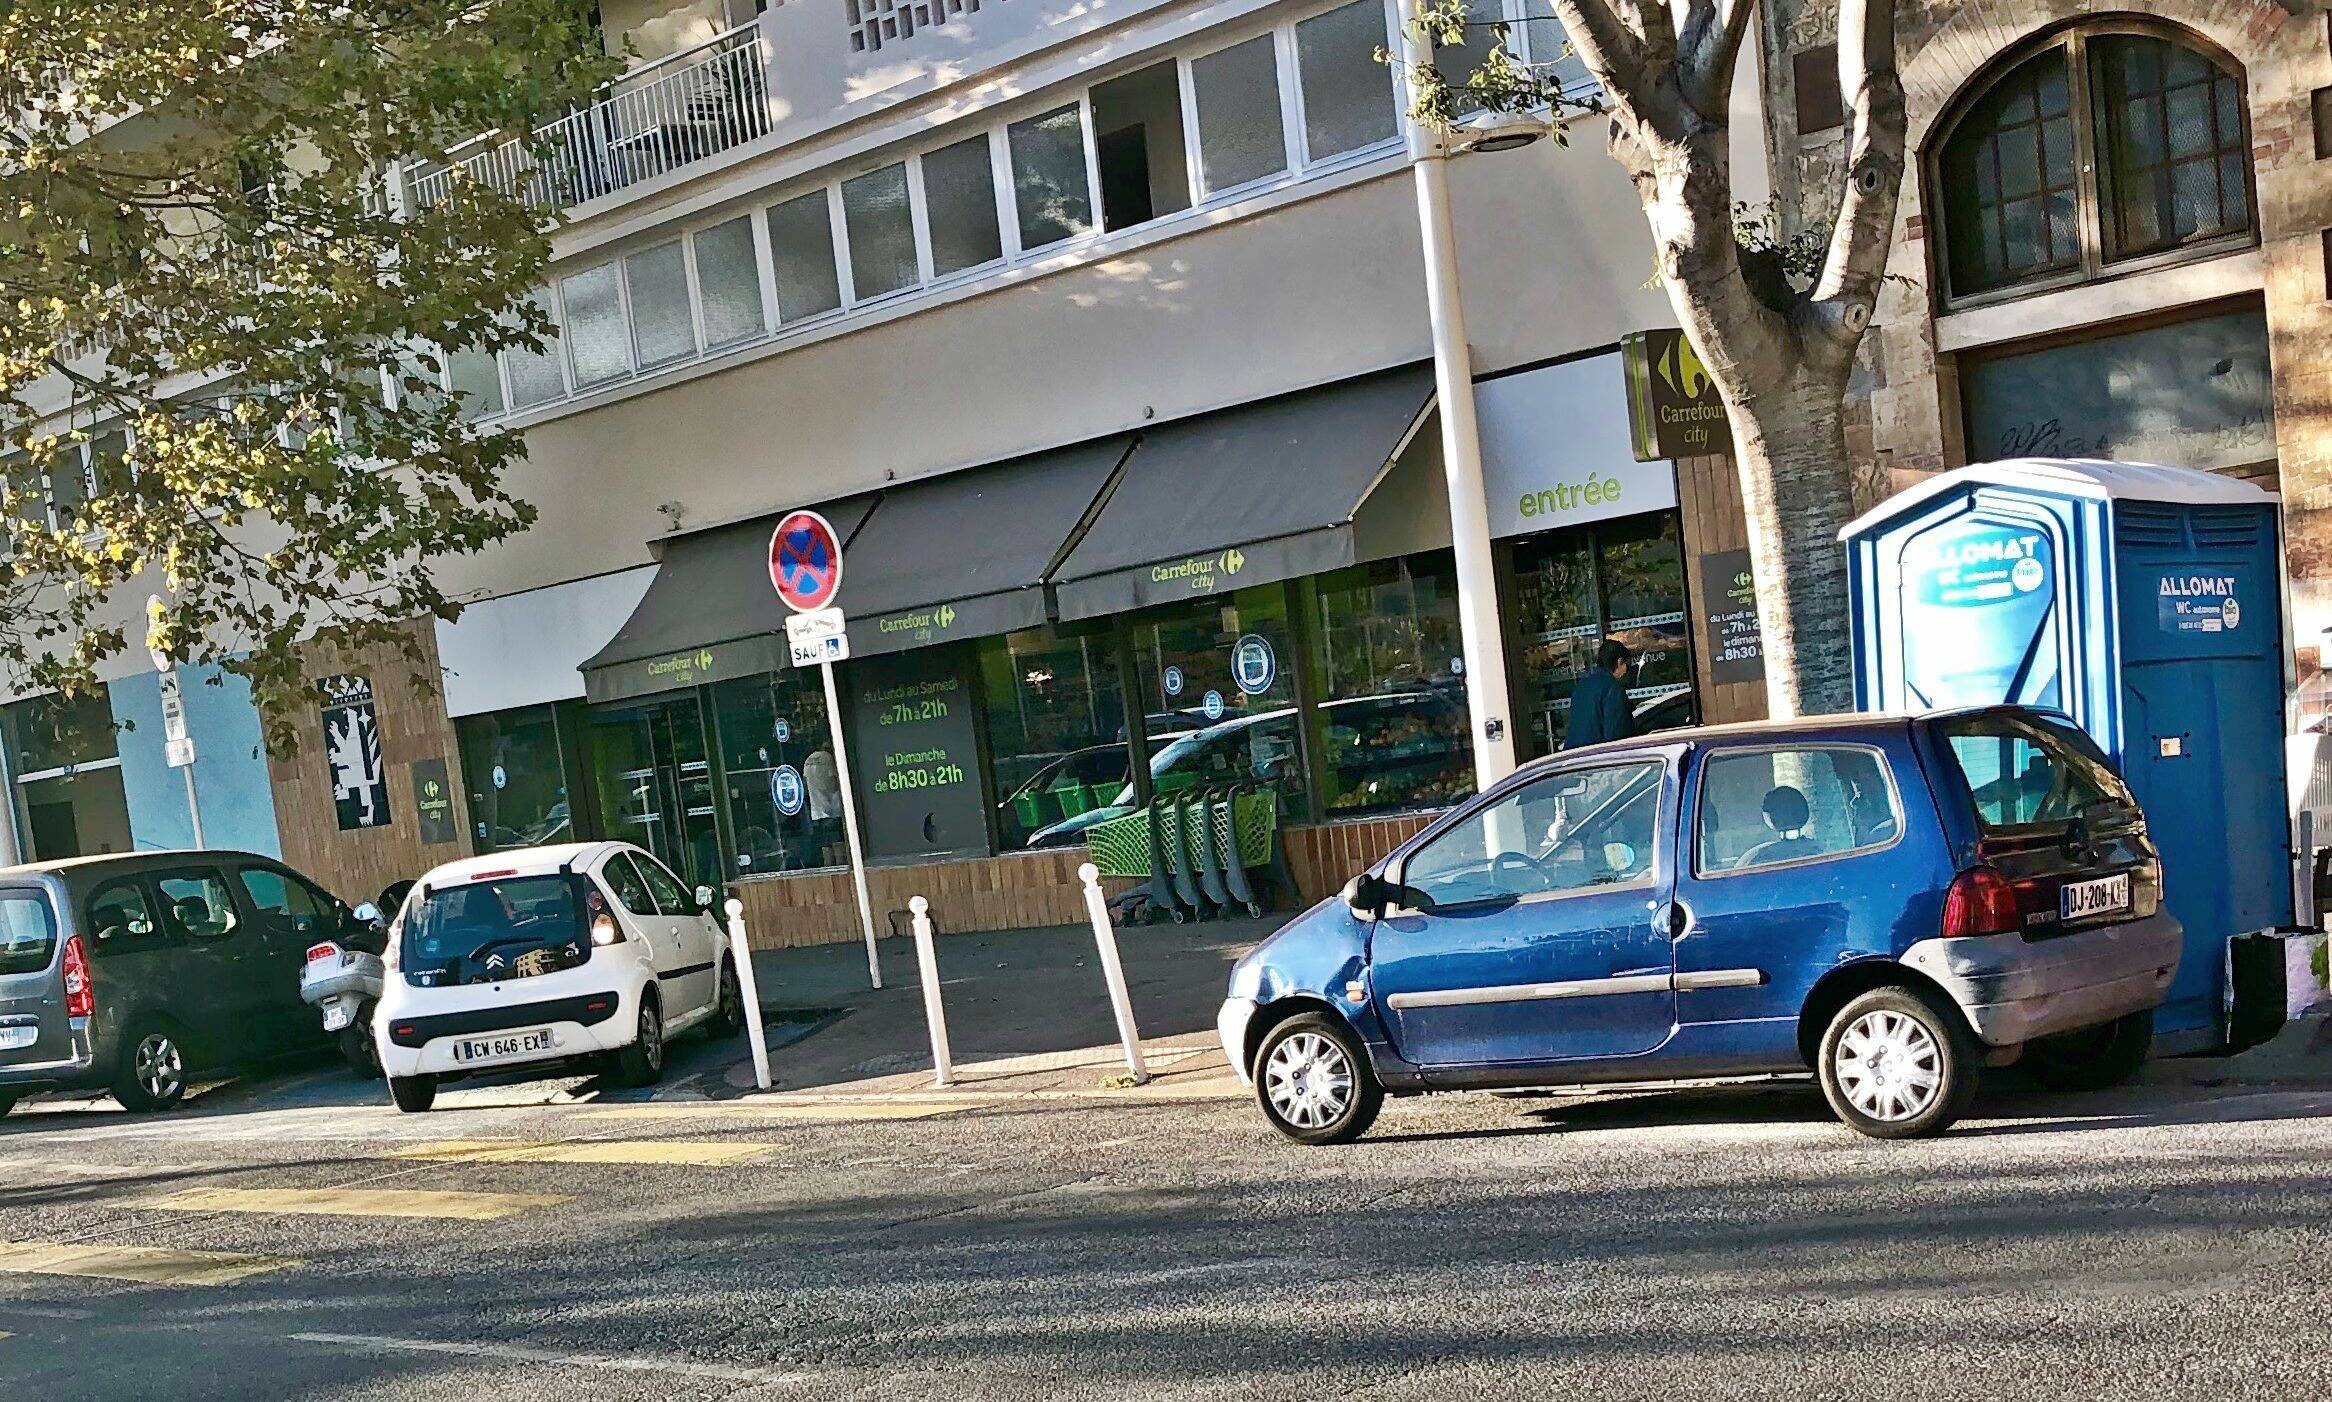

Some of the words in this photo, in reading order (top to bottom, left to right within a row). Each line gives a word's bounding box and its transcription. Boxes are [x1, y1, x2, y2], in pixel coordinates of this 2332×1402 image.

[1660, 401, 1728, 424] Carrefour
[1684, 426, 1708, 449] city
[1519, 472, 1621, 518] entrée
[1151, 559, 1215, 582] Carrefour
[1191, 575, 1215, 593] city
[2159, 577, 2235, 596] ALLOMAT
[1721, 610, 1745, 621] Lundi
[2175, 601, 2191, 614] WC
[879, 613, 931, 633] Carrefour
[1729, 621, 1746, 633] 7h
[1731, 635, 1761, 647] diman
[794, 643, 824, 661] SAUF
[1724, 646, 1757, 661] 8h30
[647, 657, 692, 676] Carrefour
[880, 712, 893, 726] de
[892, 703, 913, 722] 7h
[921, 699, 947, 719] 21h
[885, 754, 895, 767] le
[895, 747, 947, 765] Dimanche
[875, 778, 888, 792] de
[888, 768, 928, 790] 8h30
[936, 763, 963, 784] 21h
